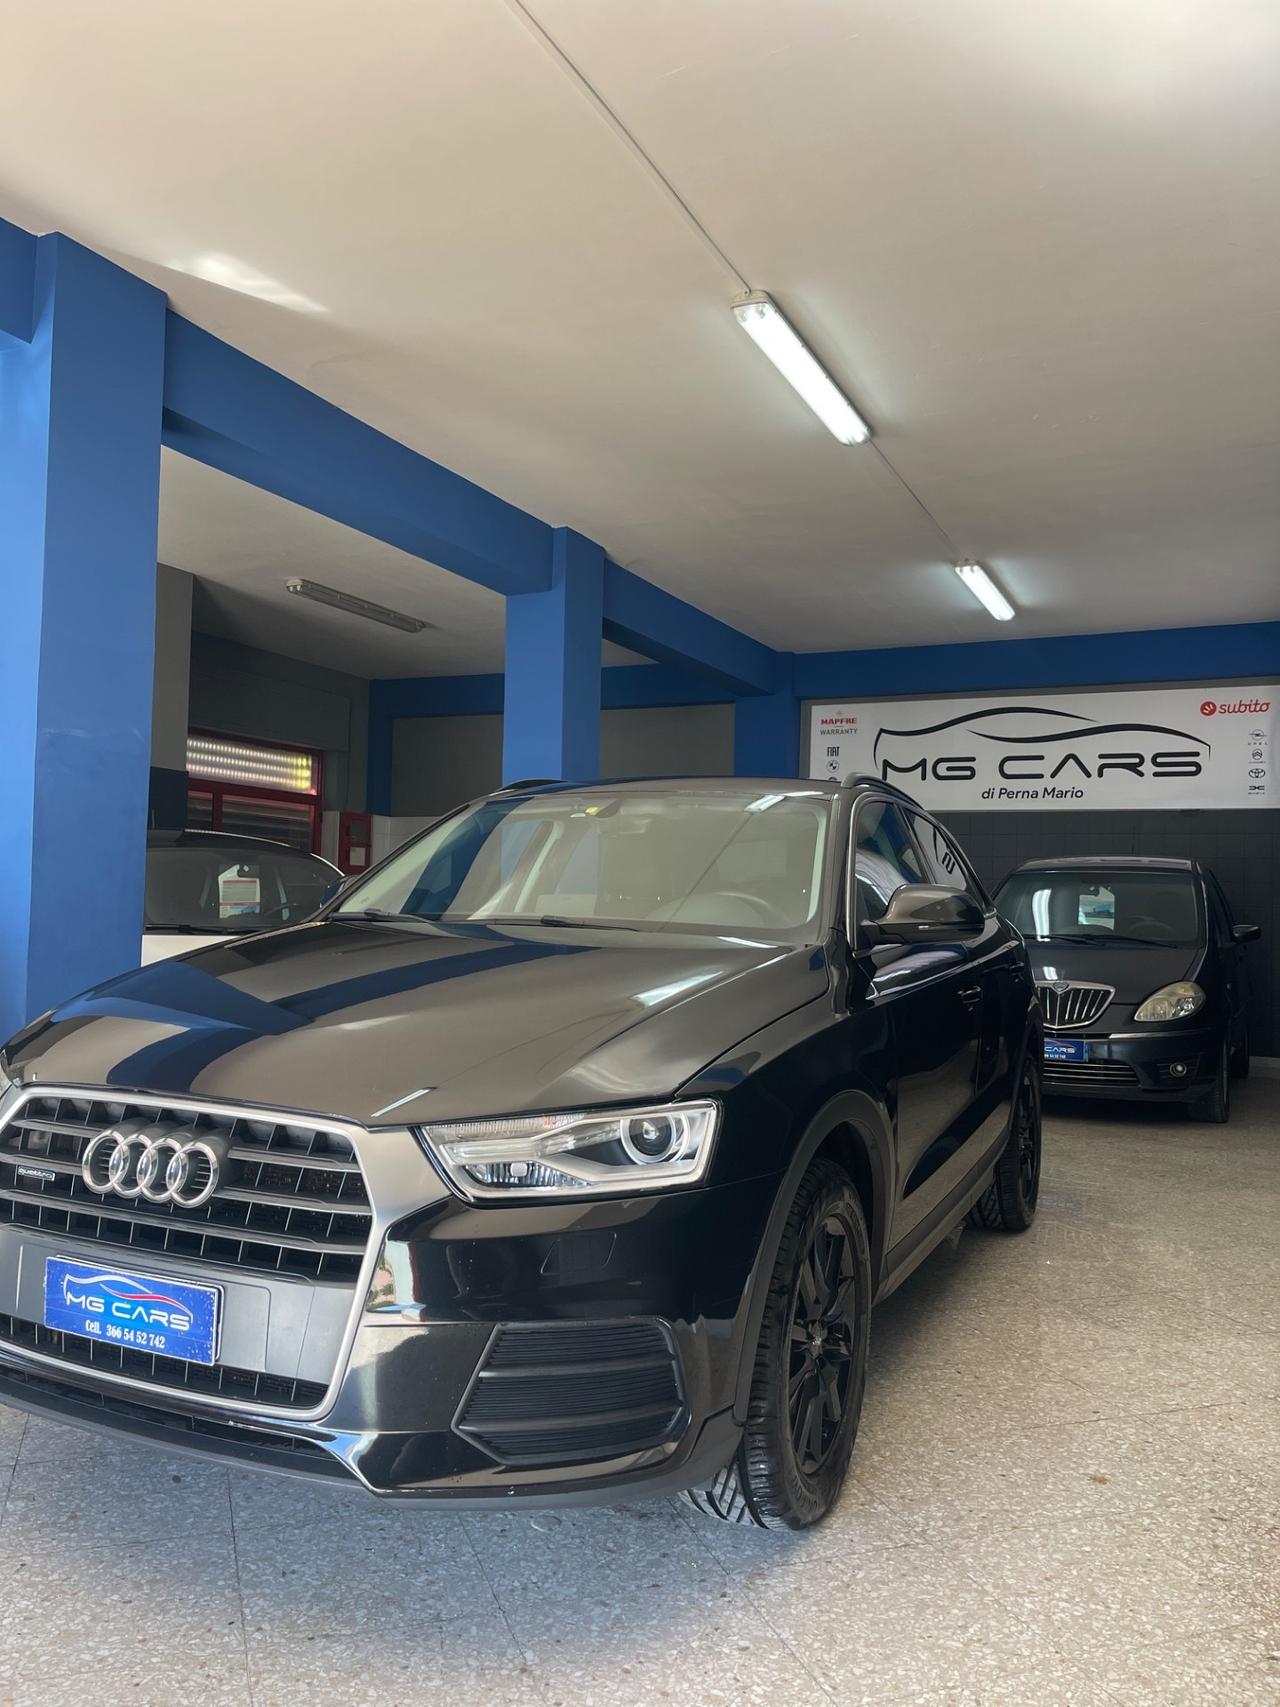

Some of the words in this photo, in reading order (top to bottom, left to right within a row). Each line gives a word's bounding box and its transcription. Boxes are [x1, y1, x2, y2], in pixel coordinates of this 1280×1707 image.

[1218, 699, 1271, 714] subito
[821, 717, 857, 726] MAPFRE
[820, 727, 858, 736] WARRANTY
[826, 746, 840, 757] FIAT
[882, 756, 977, 782] MG
[998, 751, 1202, 779] CARS
[981, 787, 996, 799] di
[998, 787, 1039, 799] Perna
[1042, 786, 1084, 799] Mario
[66, 1291, 105, 1313] MG
[111, 1301, 190, 1331] CARS
[106, 1324, 122, 1339] 366
[123, 1328, 135, 1342] 54
[136, 1331, 148, 1345] 52
[149, 1334, 166, 1349] 742
